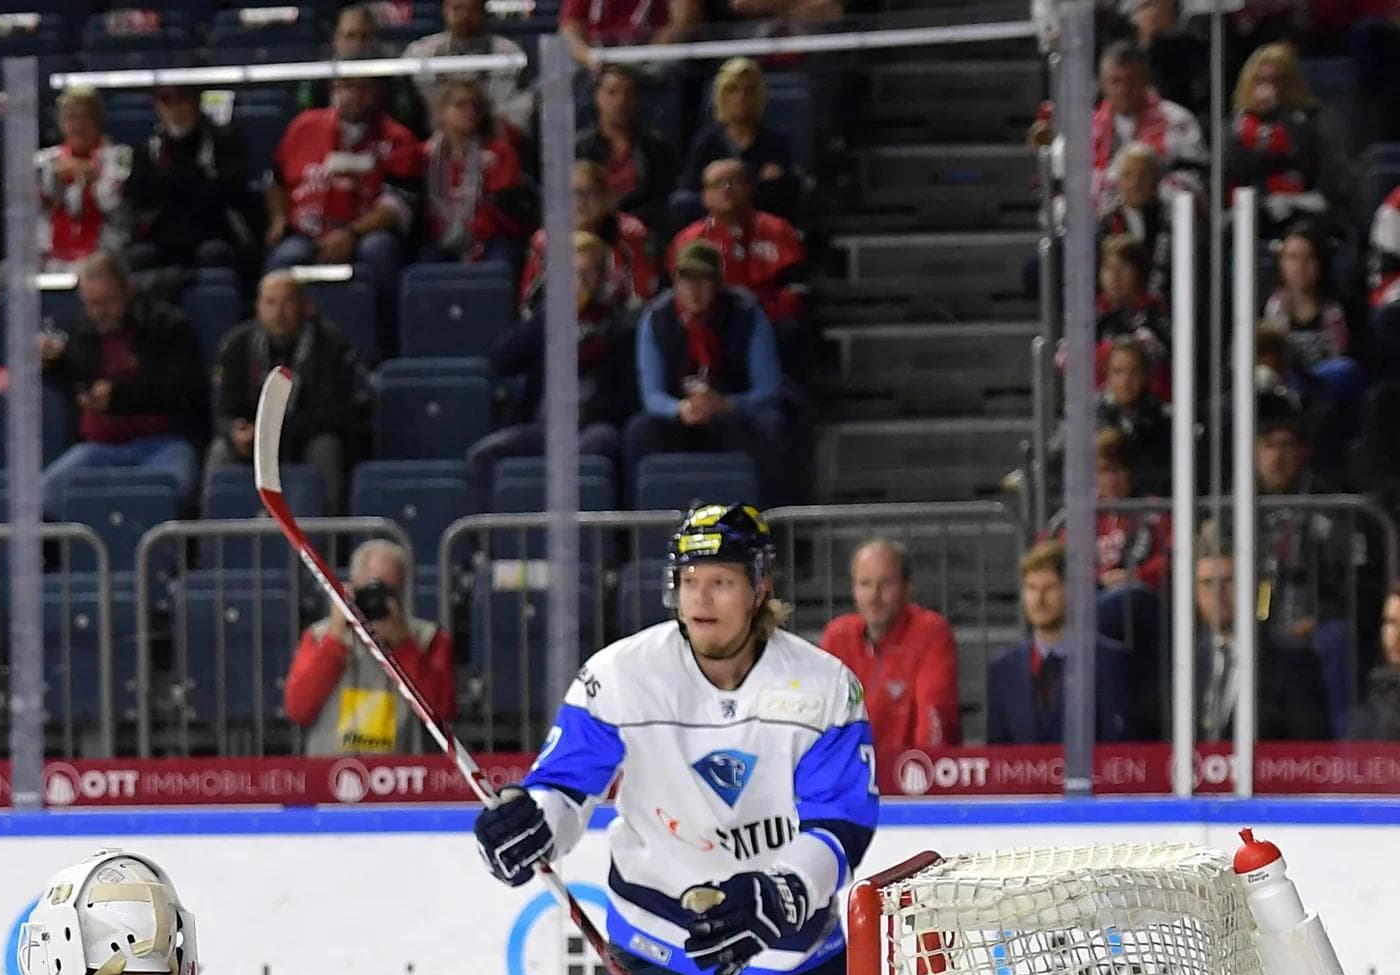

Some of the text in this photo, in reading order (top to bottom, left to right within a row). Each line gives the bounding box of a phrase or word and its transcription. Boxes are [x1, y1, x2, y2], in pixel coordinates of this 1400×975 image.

[80, 770, 305, 798] OTT IMMOBILIEN
[369, 766, 427, 795] OTT
[935, 756, 989, 787] OTT
